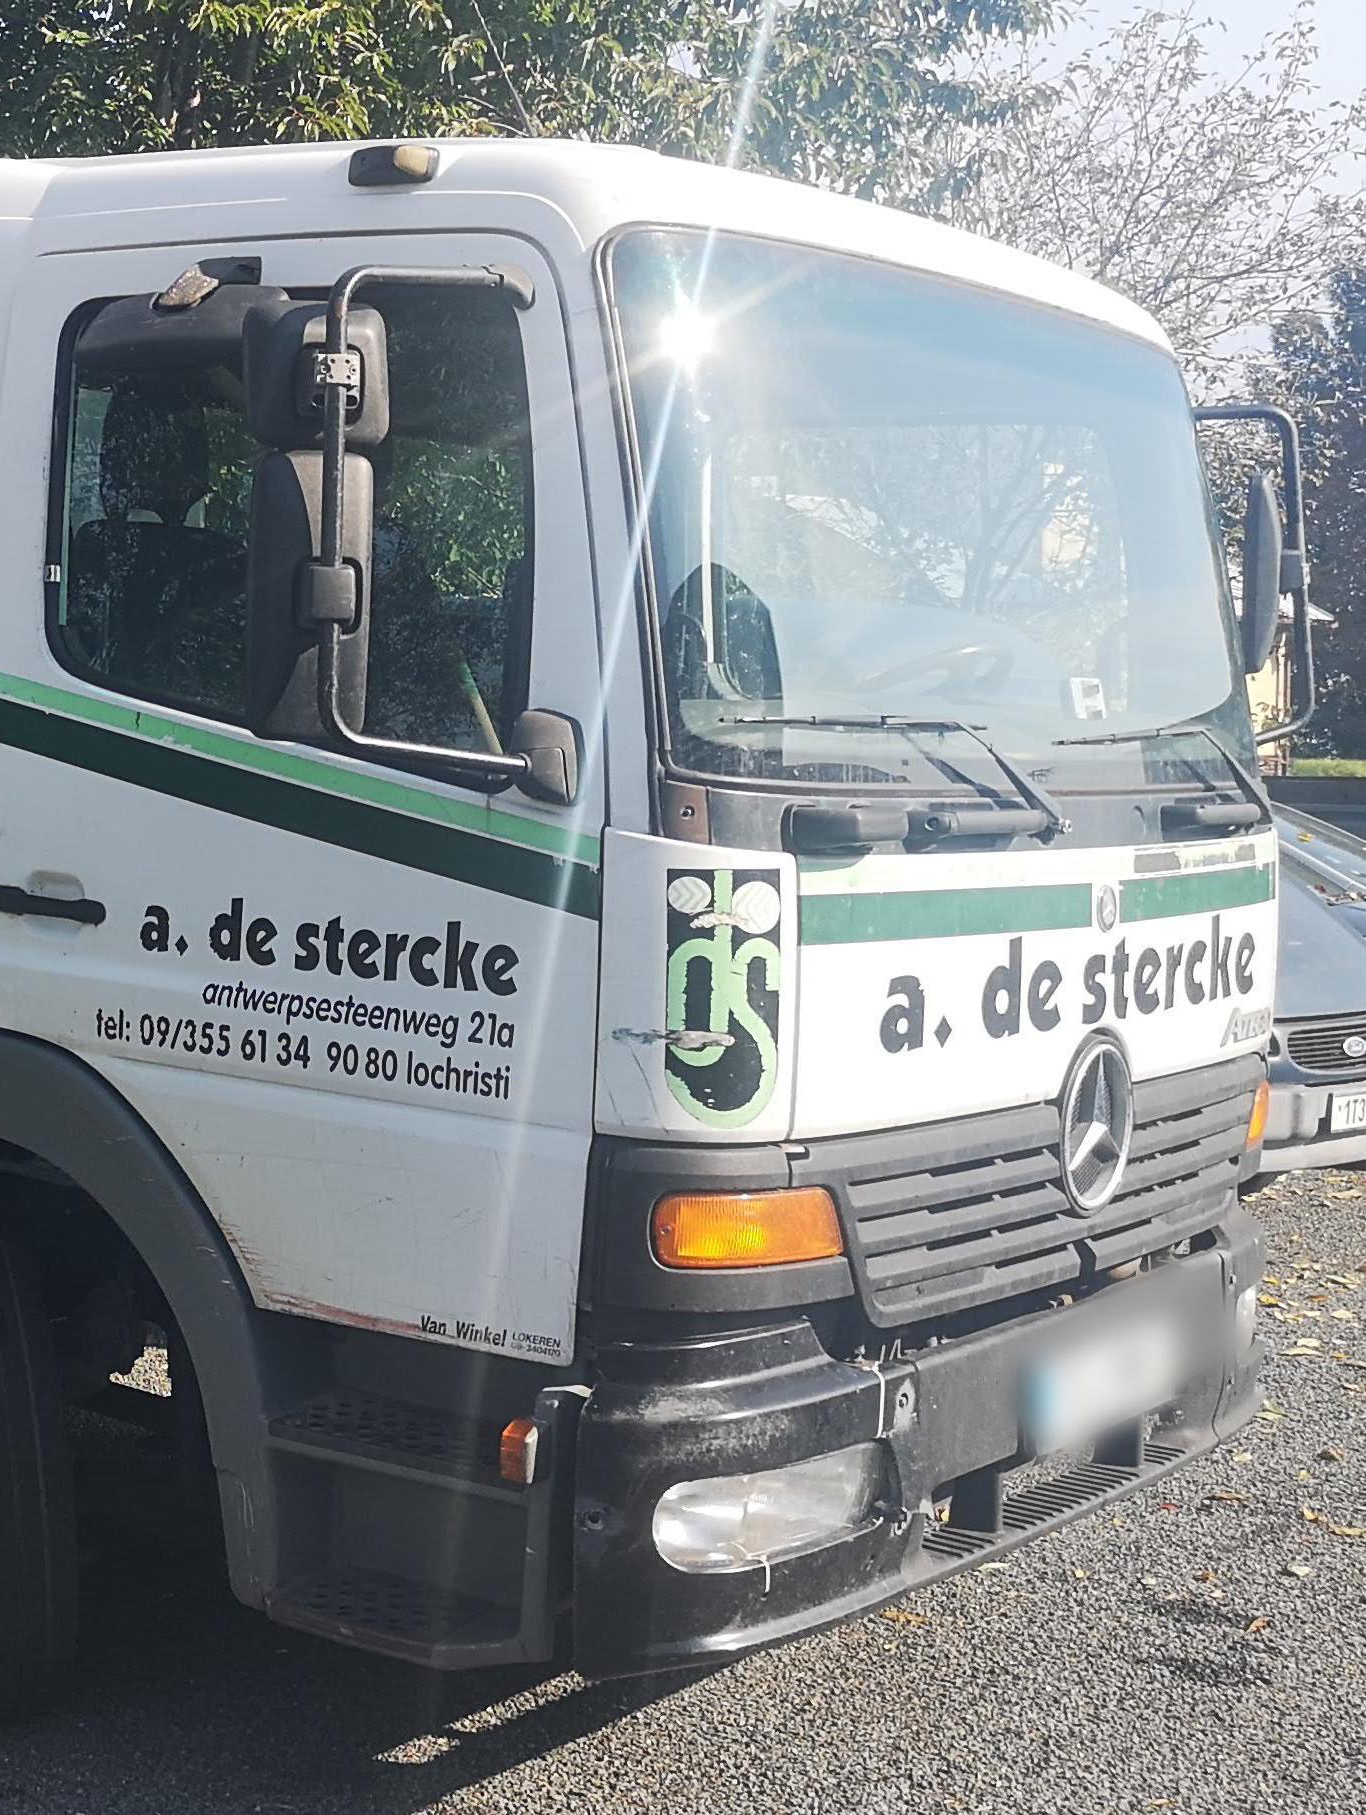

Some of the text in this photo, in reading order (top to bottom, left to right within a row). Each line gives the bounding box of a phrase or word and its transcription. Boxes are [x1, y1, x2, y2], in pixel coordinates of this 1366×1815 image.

[208, 897, 278, 967] de
[294, 915, 520, 997] stercke
[982, 936, 1063, 1039] de
[1082, 914, 1255, 1025] stercke
[95, 1007, 131, 1043] tel:
[139, 1013, 231, 1058] 09/355
[406, 1050, 511, 1100] lochristi
[201, 980, 515, 1049] antwerpsesteenweg 21a
[420, 1314, 562, 1349] Van Winkel LOKEREN
